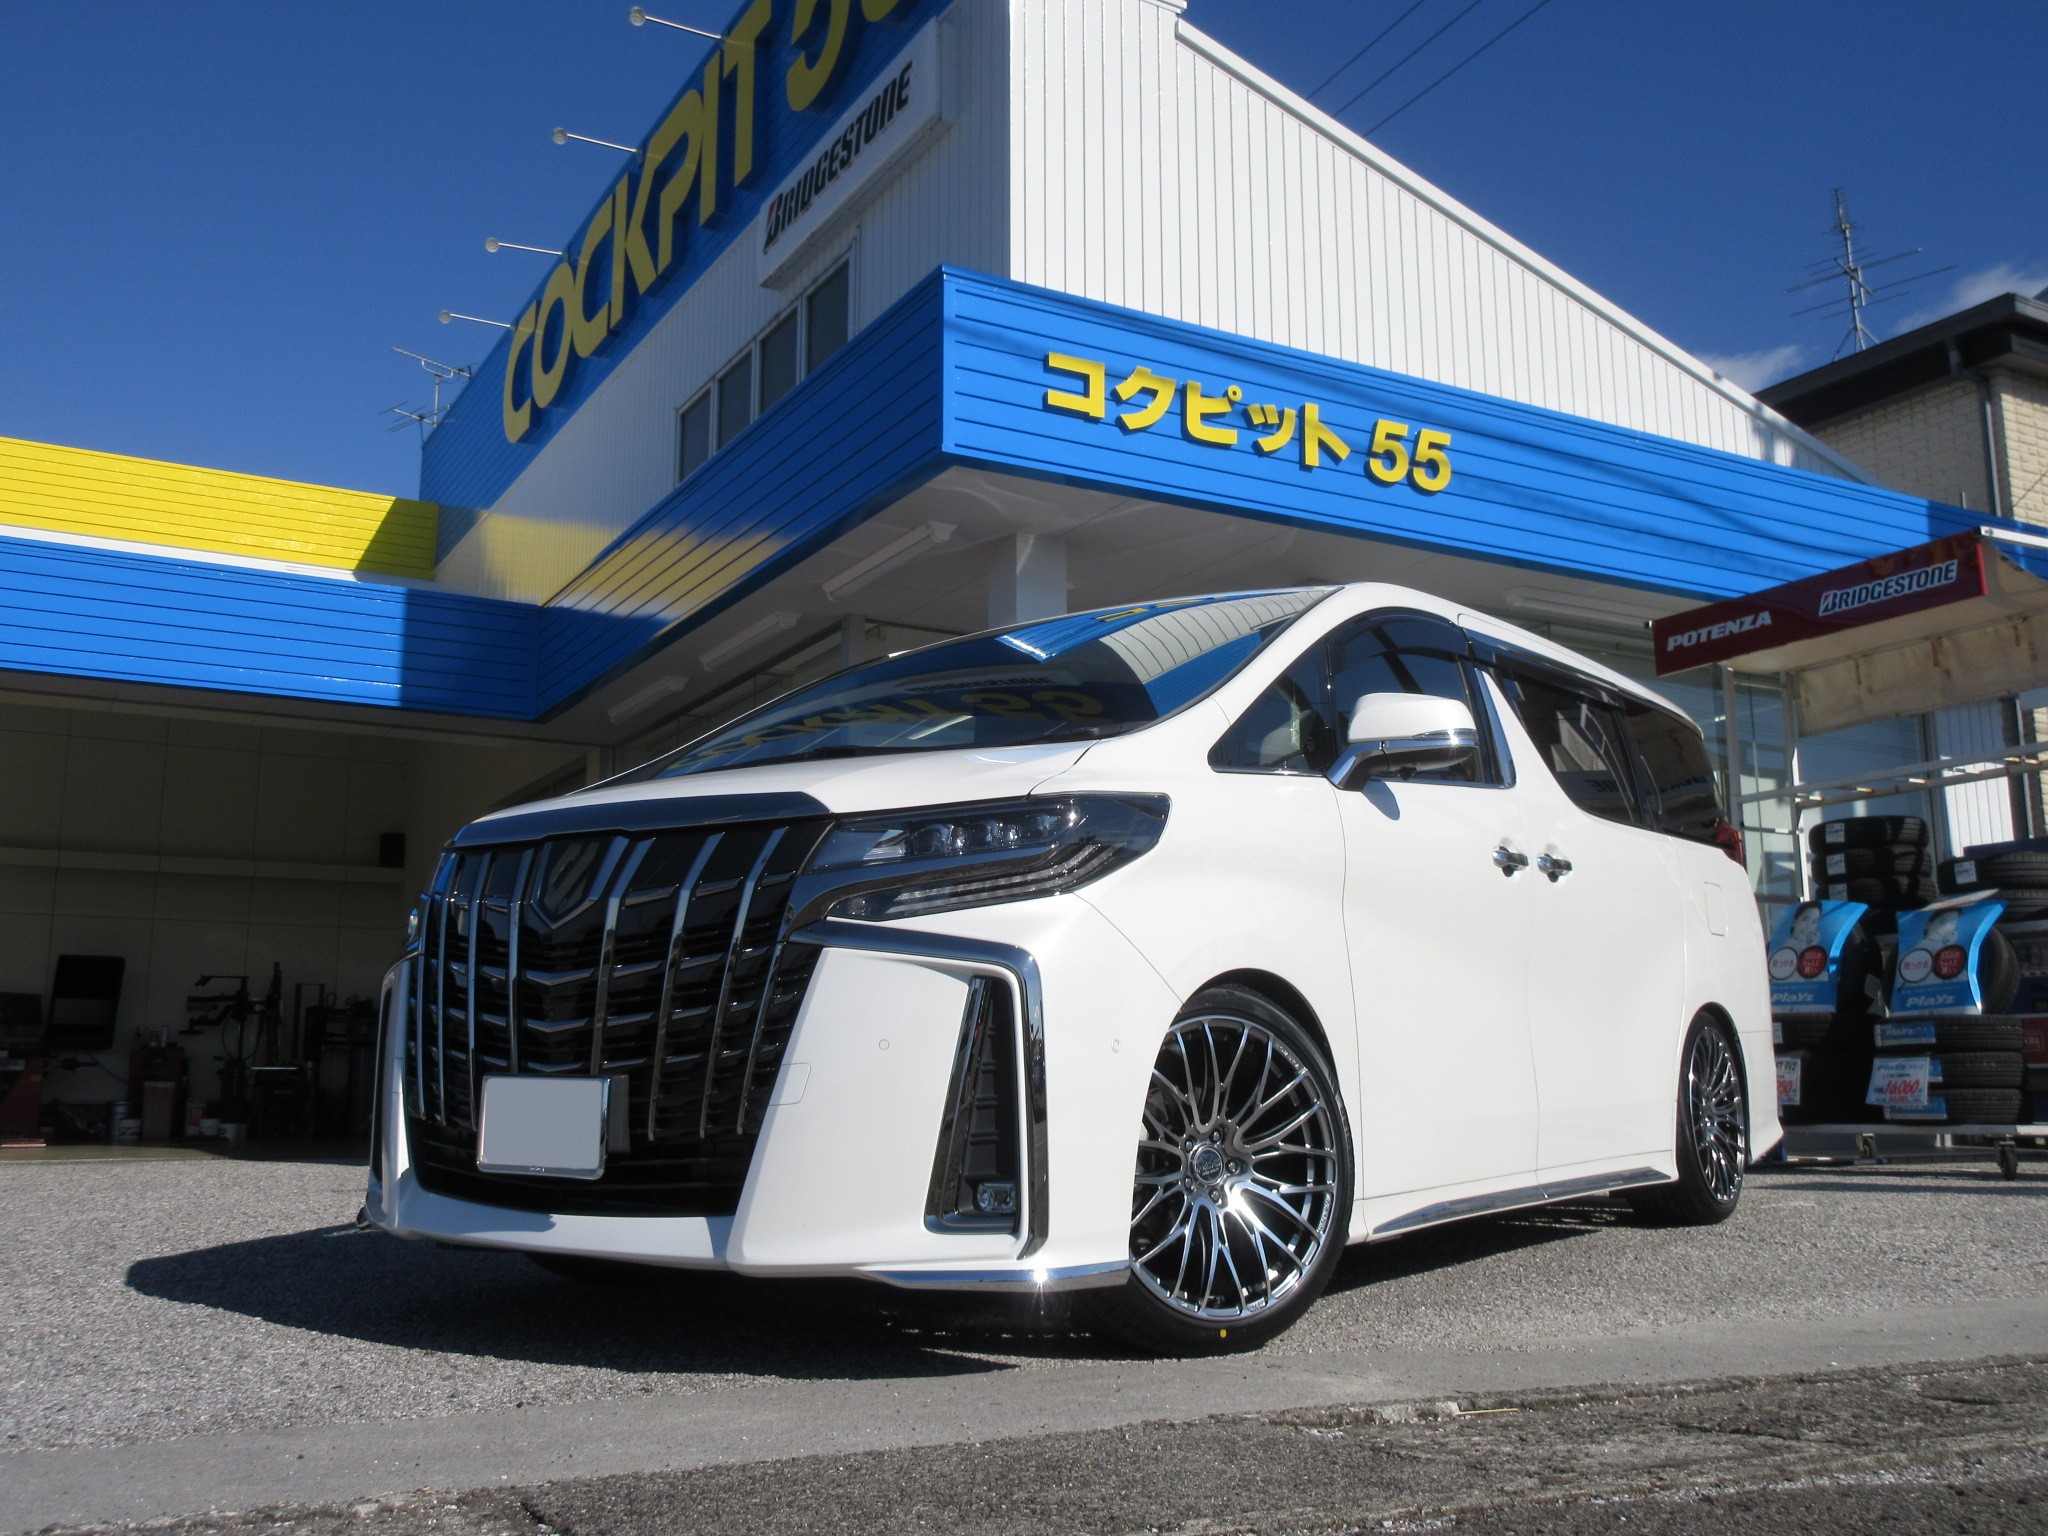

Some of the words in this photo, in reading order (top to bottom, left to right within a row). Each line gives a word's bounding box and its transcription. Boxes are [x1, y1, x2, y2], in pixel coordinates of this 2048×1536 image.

[503, 0, 772, 444] COCKPIT
[763, 60, 914, 255] BRIDGESTONE
[1047, 351, 1351, 467] コクピット
[1368, 418, 1452, 492] 55
[1666, 610, 1772, 652] POTENZA
[1818, 559, 1958, 617] BRIDGESTONE
